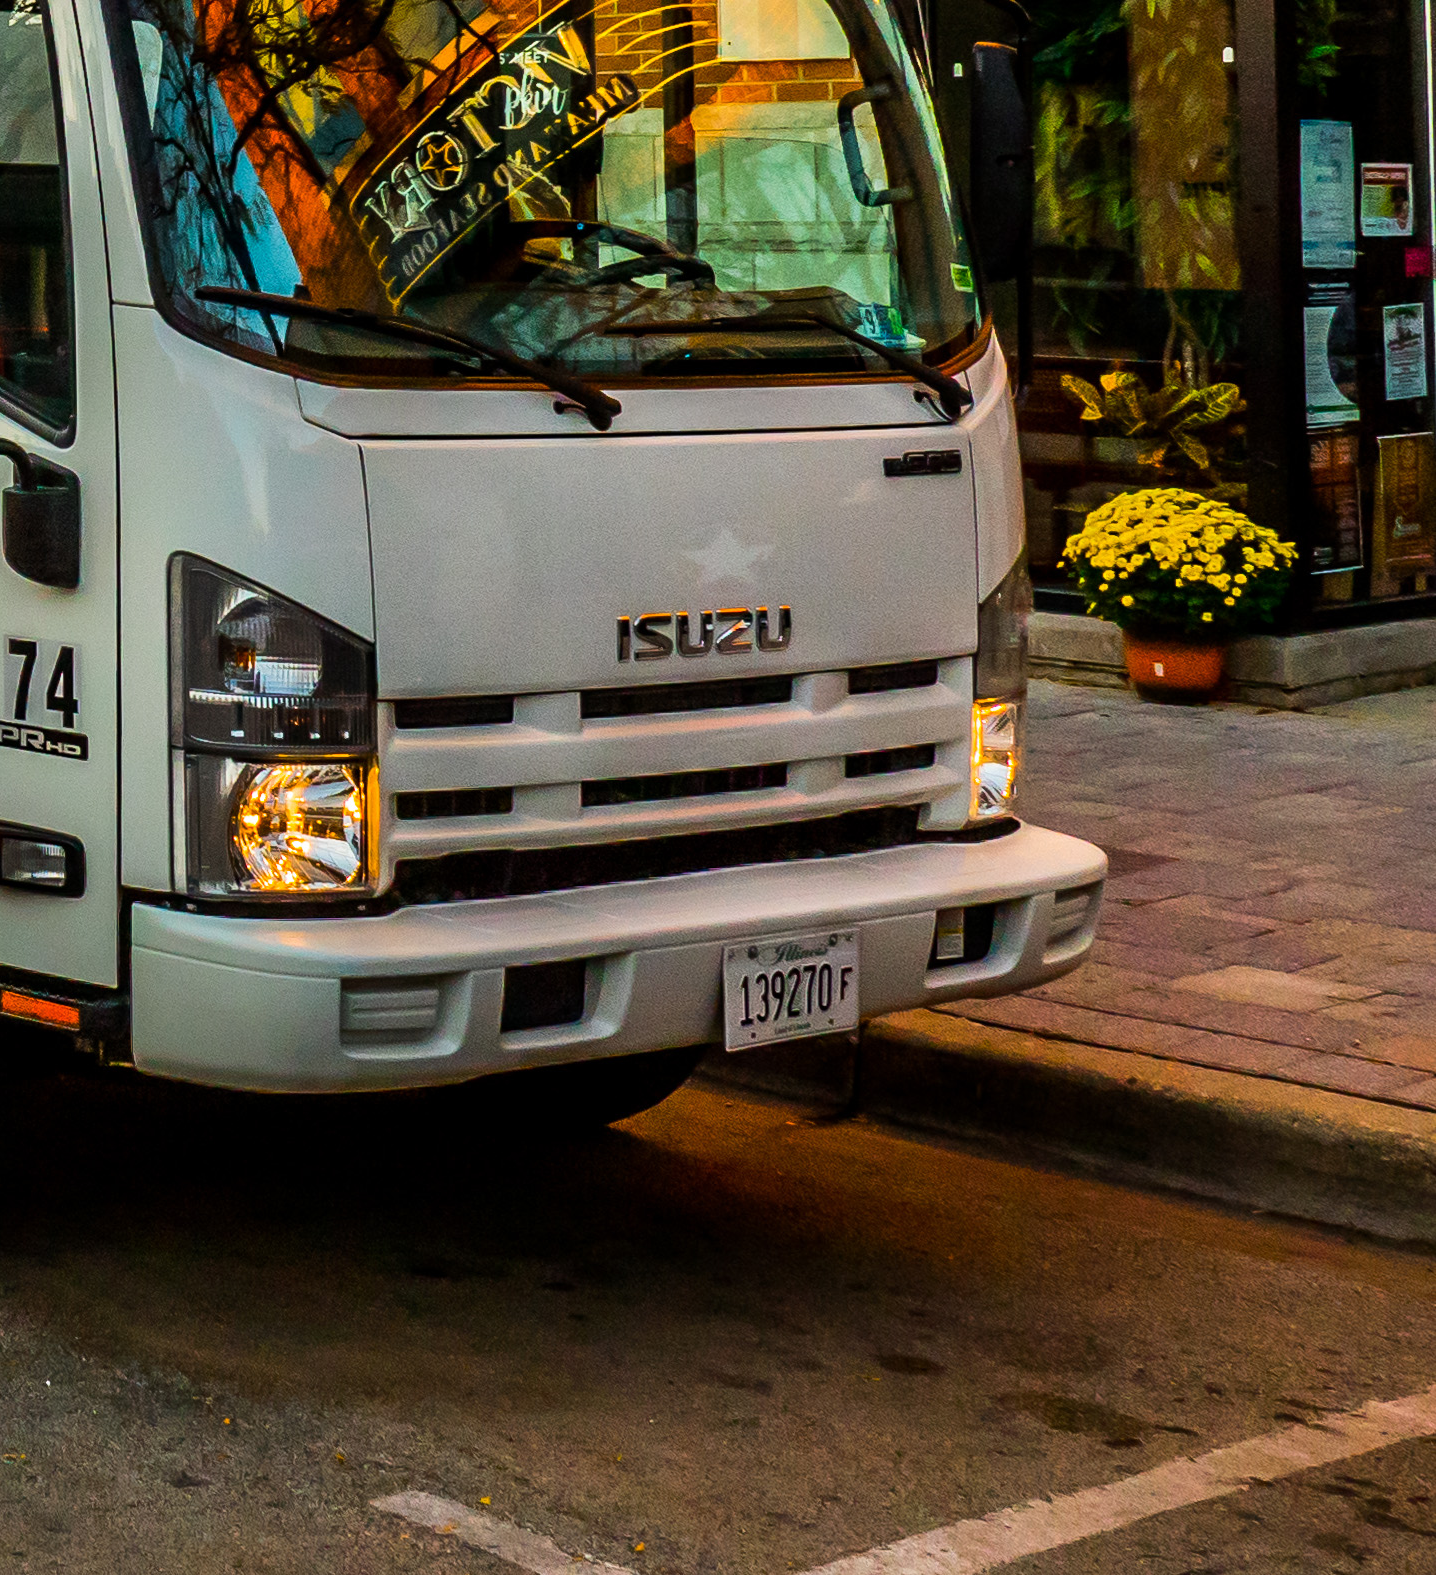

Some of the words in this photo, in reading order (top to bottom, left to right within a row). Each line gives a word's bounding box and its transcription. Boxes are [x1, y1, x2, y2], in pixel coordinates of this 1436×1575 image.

[616, 604, 793, 663] ISUZU
[7, 637, 81, 729] 74
[739, 962, 833, 1027] 139270
[839, 965, 854, 1001] F
